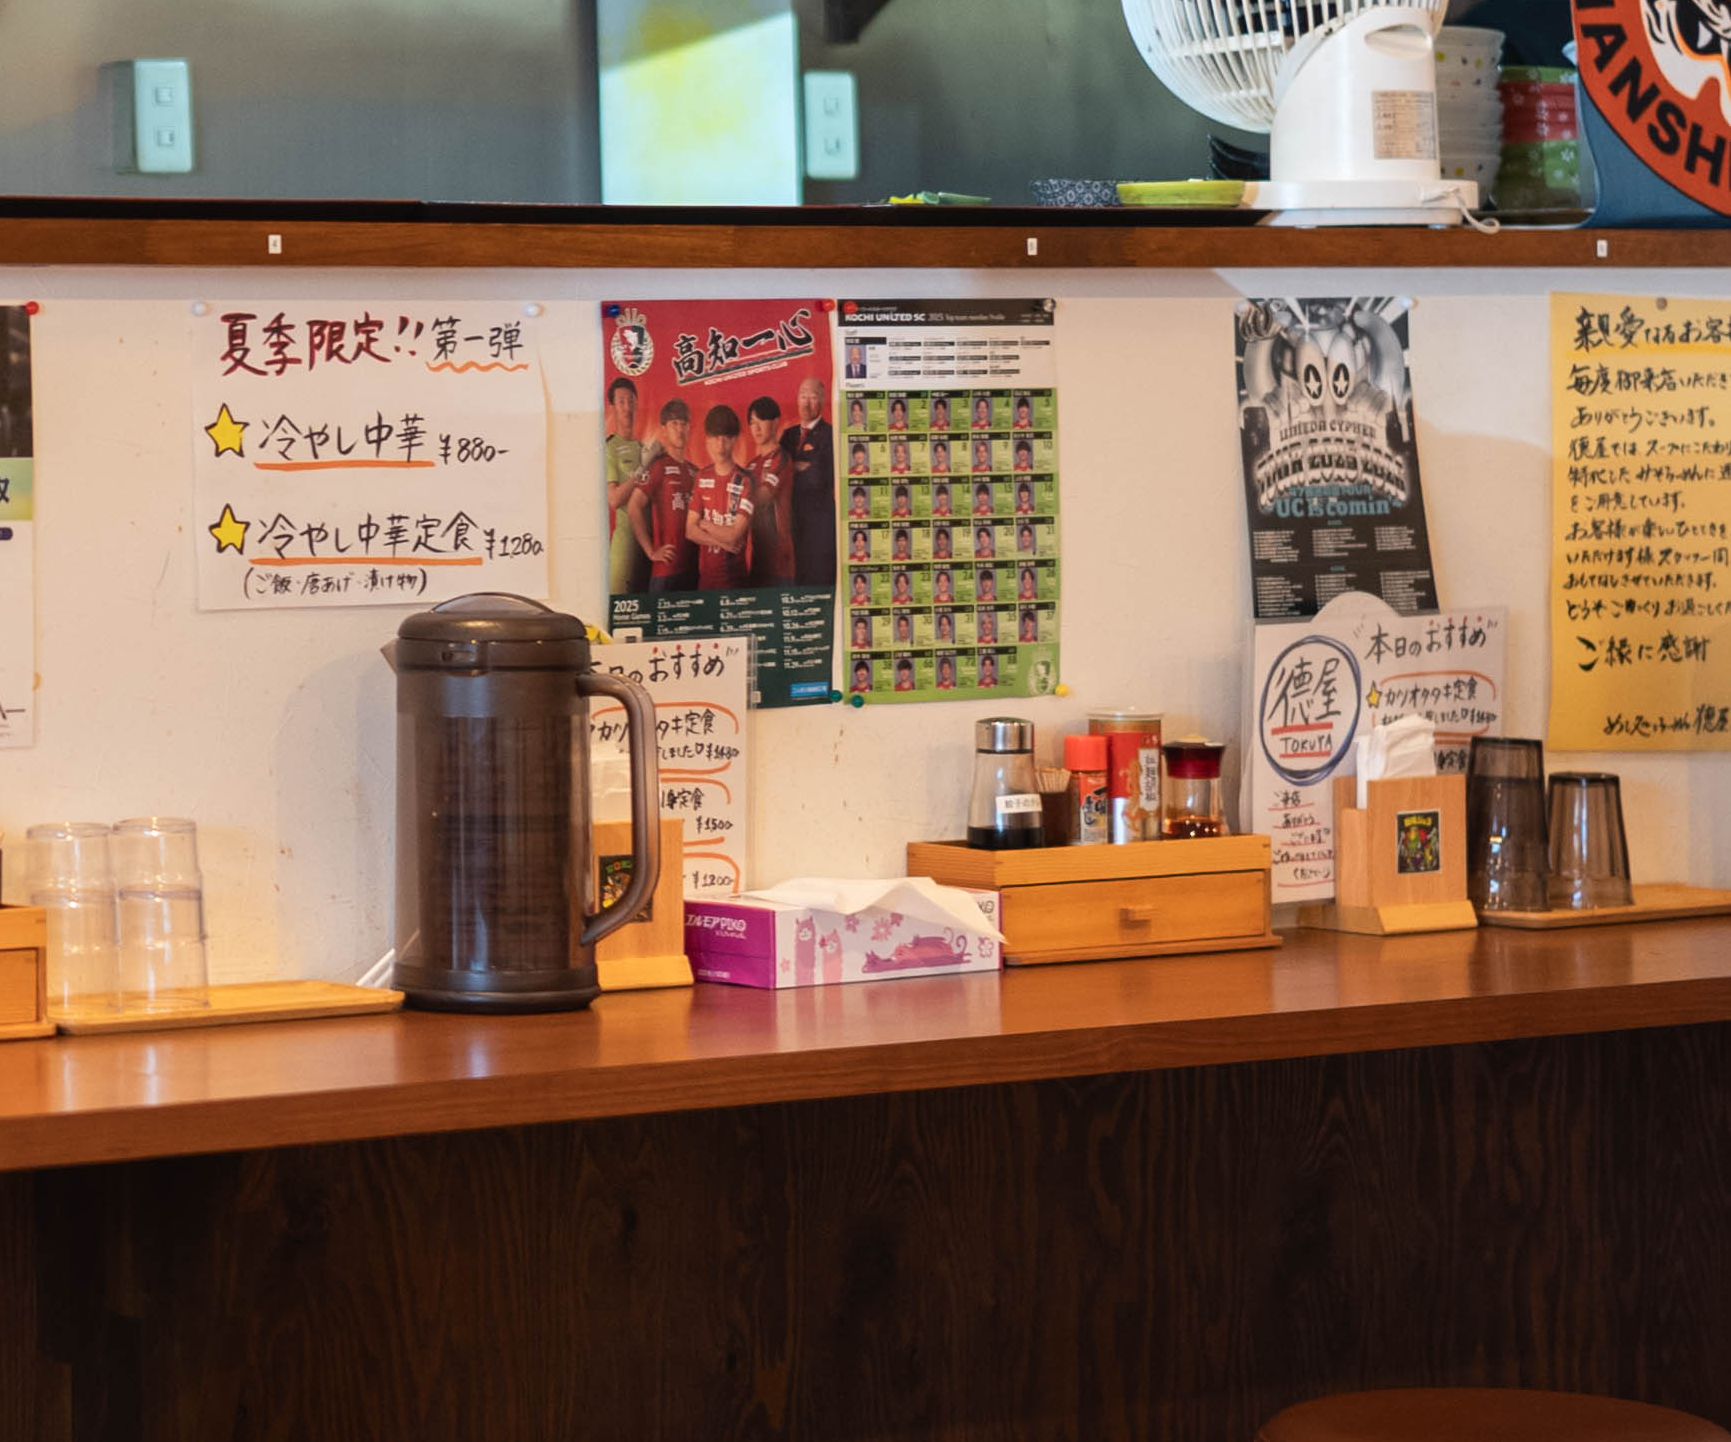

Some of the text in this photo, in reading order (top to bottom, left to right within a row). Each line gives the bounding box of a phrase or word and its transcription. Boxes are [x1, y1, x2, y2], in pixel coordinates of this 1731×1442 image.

[430, 315, 524, 361] 第一弾
[876, 313, 911, 322] UNITED
[913, 313, 926, 322] SC
[1574, 305, 1731, 353] 親愛なるお客
[669, 309, 814, 380] 高知一心
[258, 410, 427, 464] 冷やし中華
[1276, 498, 1304, 518] UC
[257, 511, 479, 560] 冷やし中華定食
[613, 600, 639, 613] 2025
[1365, 622, 1487, 664] 本日のおすすめ
[1268, 657, 1342, 726] 徳屋
[1280, 739, 1333, 754] TOKUYA
[661, 787, 704, 811] 身定食
